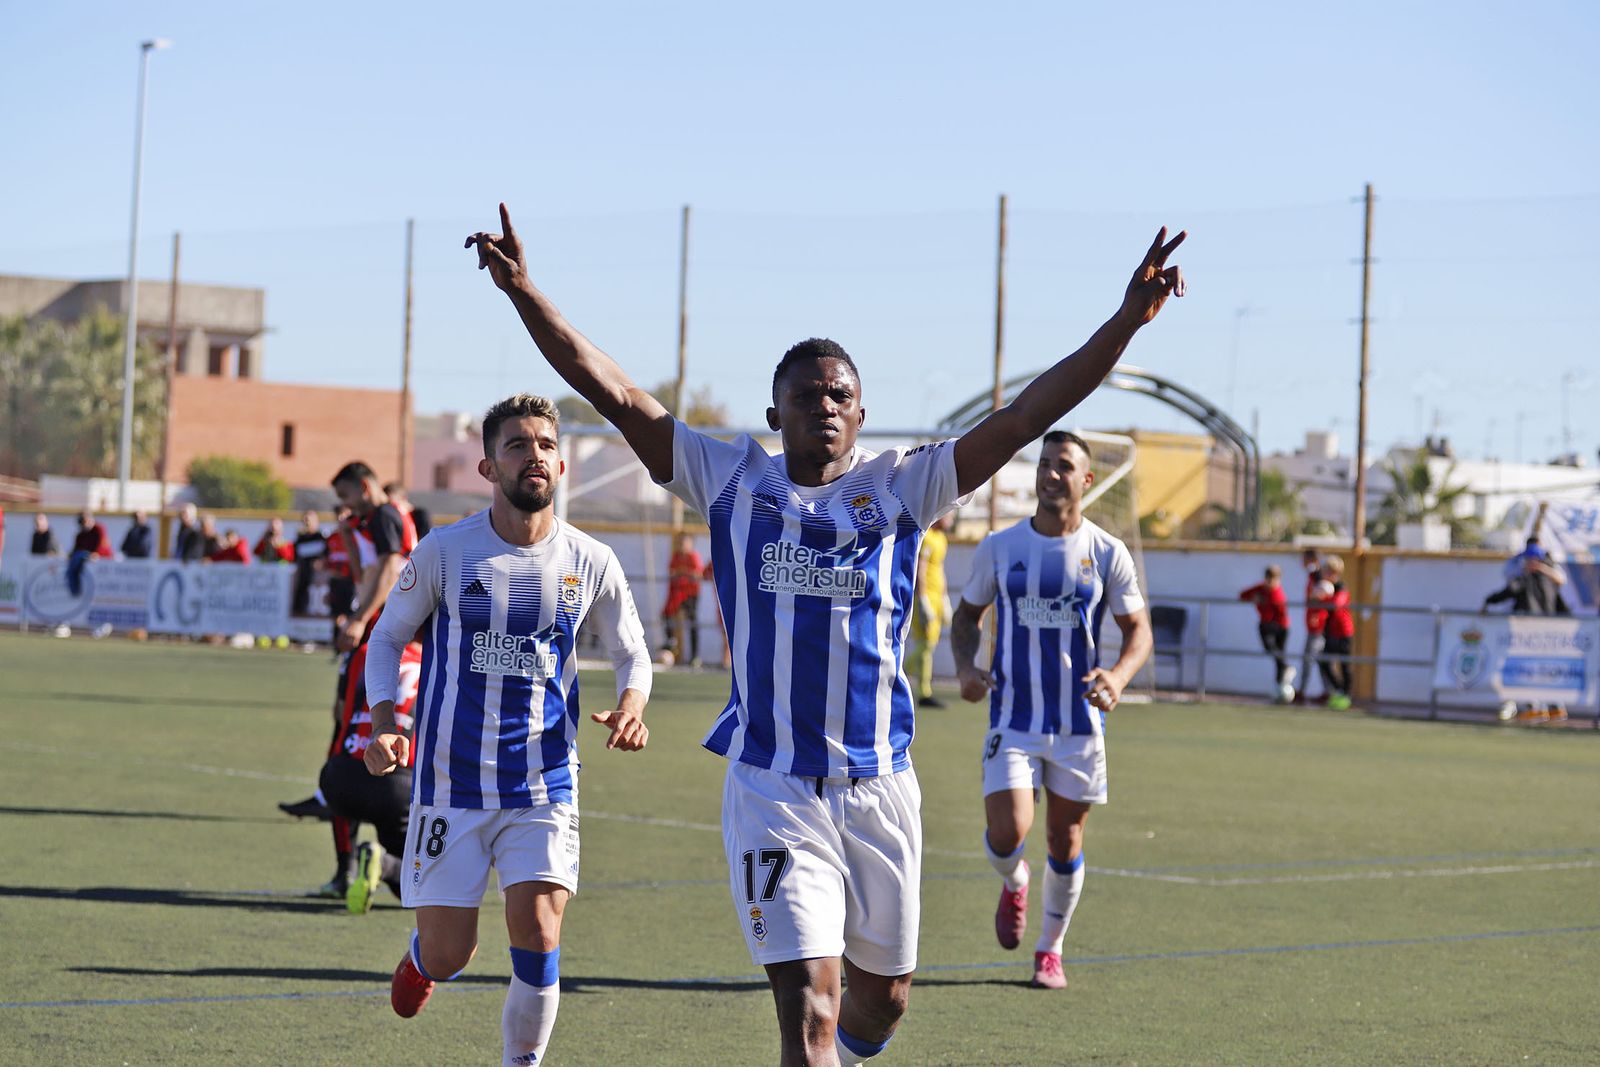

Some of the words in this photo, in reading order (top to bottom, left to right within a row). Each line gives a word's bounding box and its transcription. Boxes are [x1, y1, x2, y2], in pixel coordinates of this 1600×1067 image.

[762, 541, 823, 566] alter
[761, 564, 867, 589] enersun
[473, 631, 526, 651] alter
[472, 649, 557, 670] enersun
[415, 814, 450, 859] 18
[742, 848, 788, 903] 17
